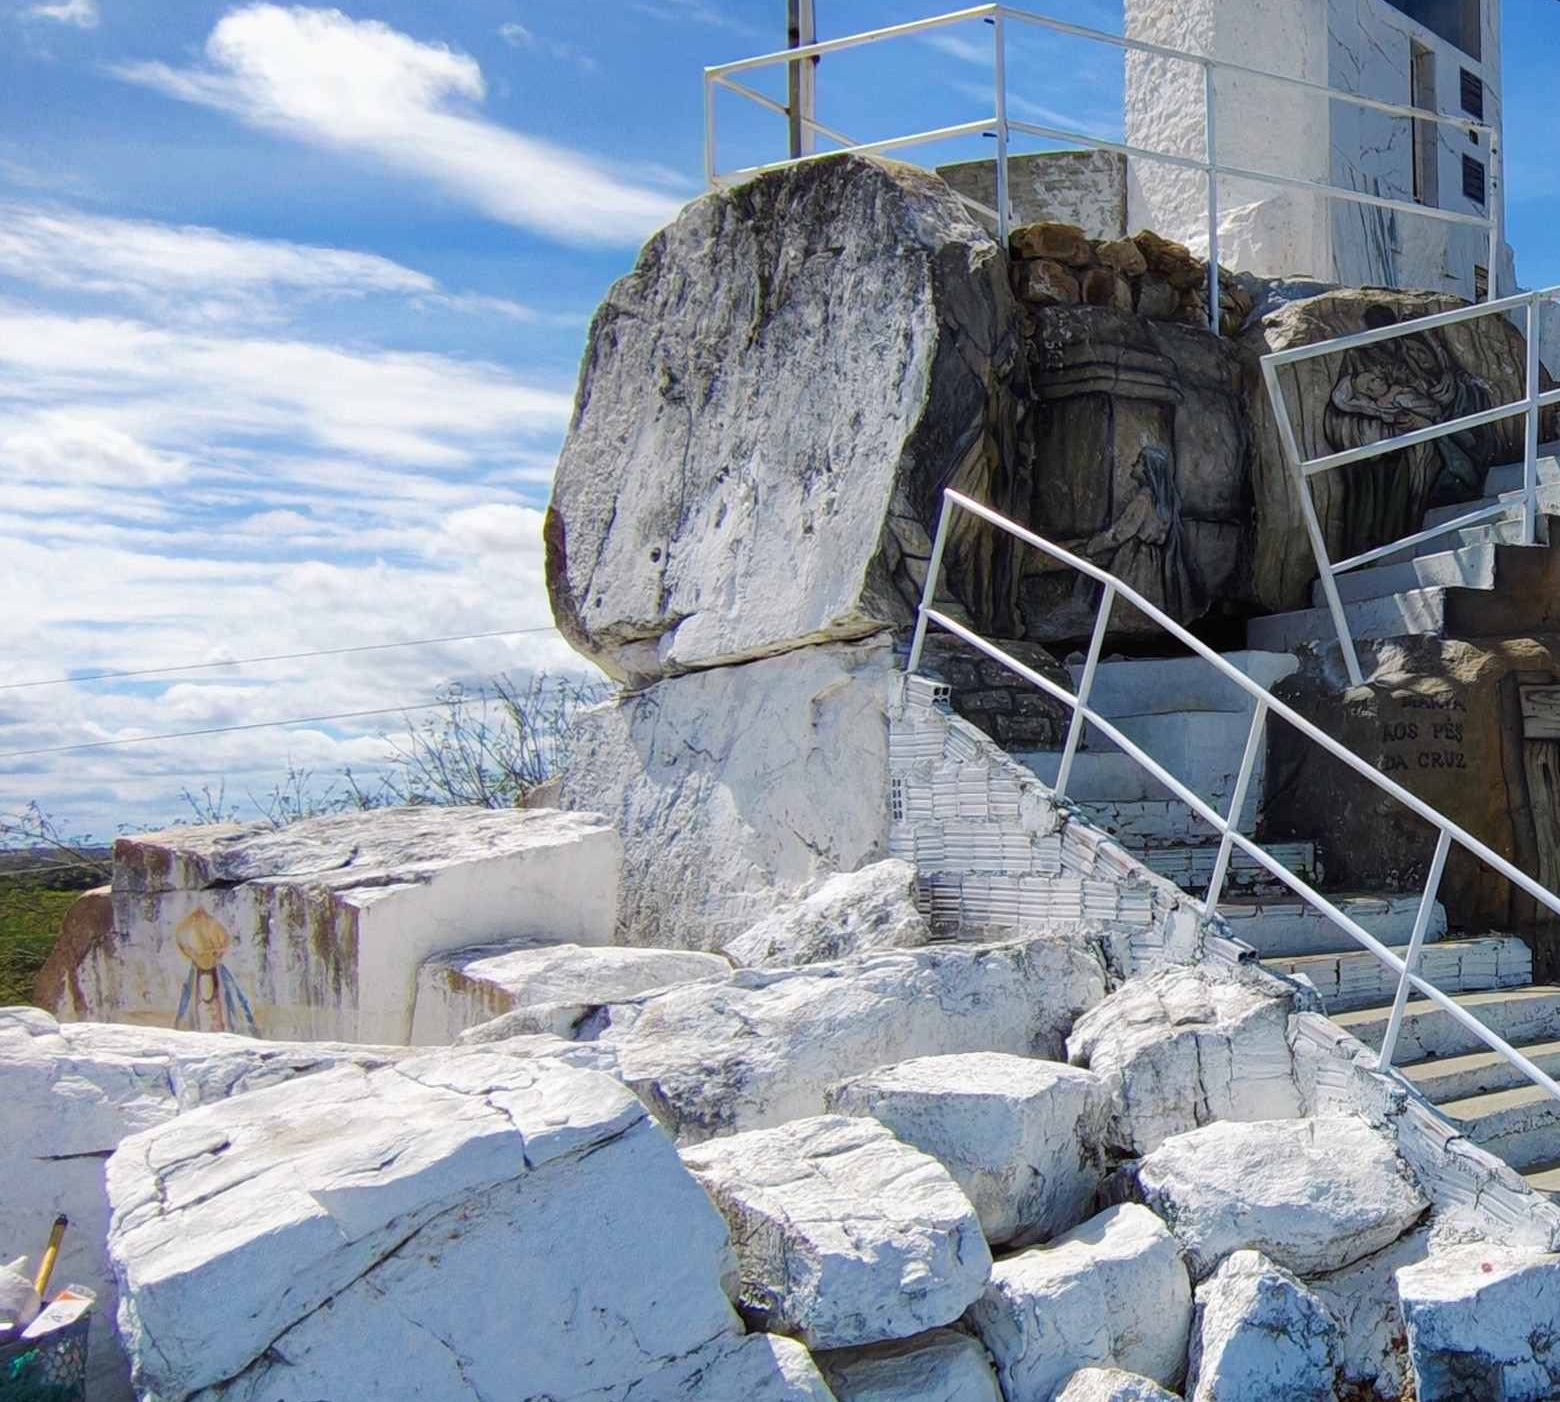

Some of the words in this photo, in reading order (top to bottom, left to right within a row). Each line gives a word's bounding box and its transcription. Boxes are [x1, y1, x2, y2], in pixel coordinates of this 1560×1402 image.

[1382, 721, 1419, 743] AOS
[1432, 717, 1464, 743] PÉS
[1383, 753, 1409, 771] DA
[1418, 751, 1468, 770] CRUZ
